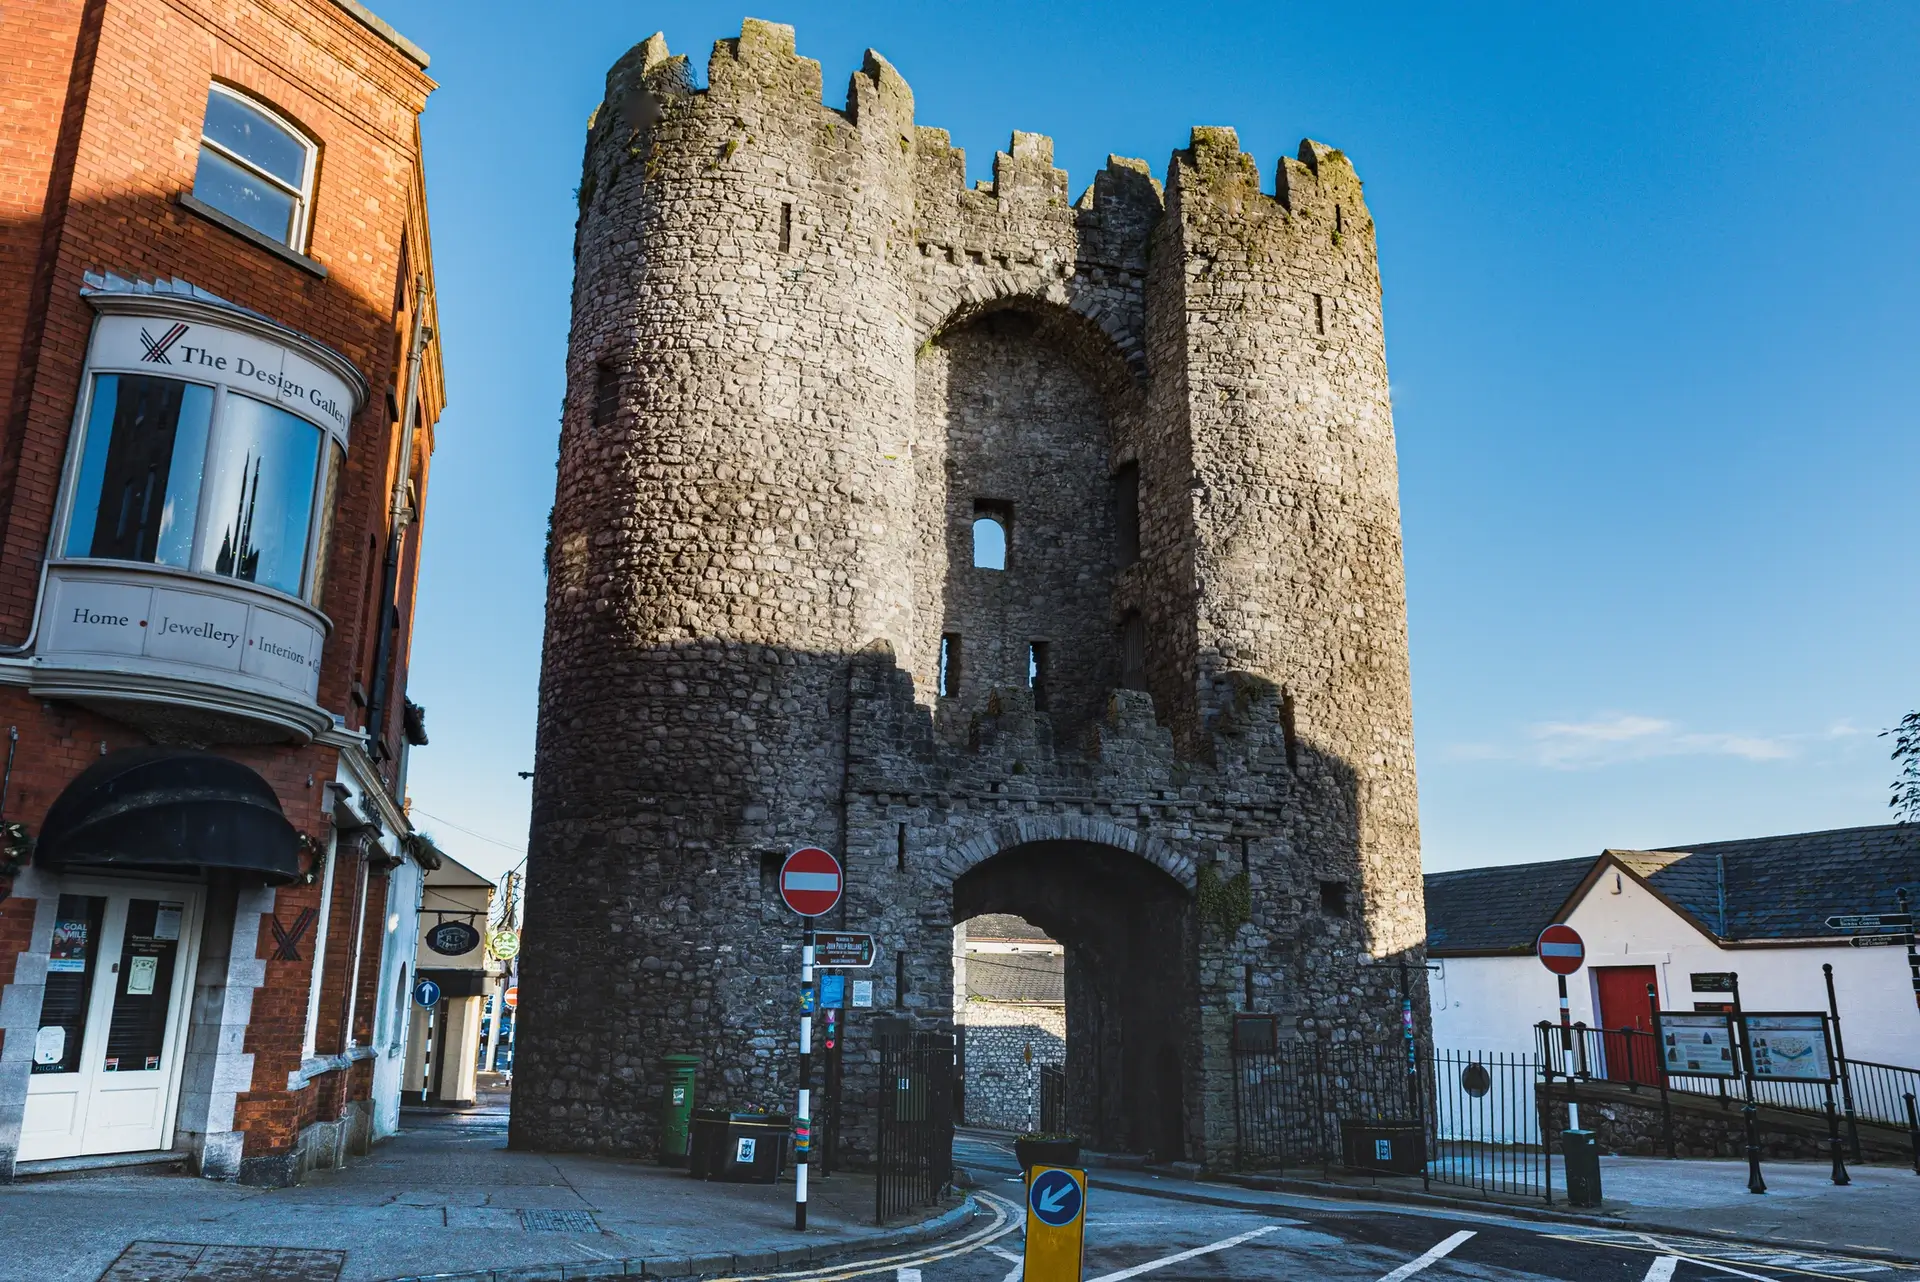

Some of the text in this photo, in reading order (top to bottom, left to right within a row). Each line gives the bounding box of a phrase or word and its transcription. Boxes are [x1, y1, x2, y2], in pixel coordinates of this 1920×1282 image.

[181, 345, 347, 431] The Design Gallery
[72, 608, 305, 664] Home Jewellery Interiors
[64, 923, 87, 931] GOAL
[66, 931, 87, 939] MILE
